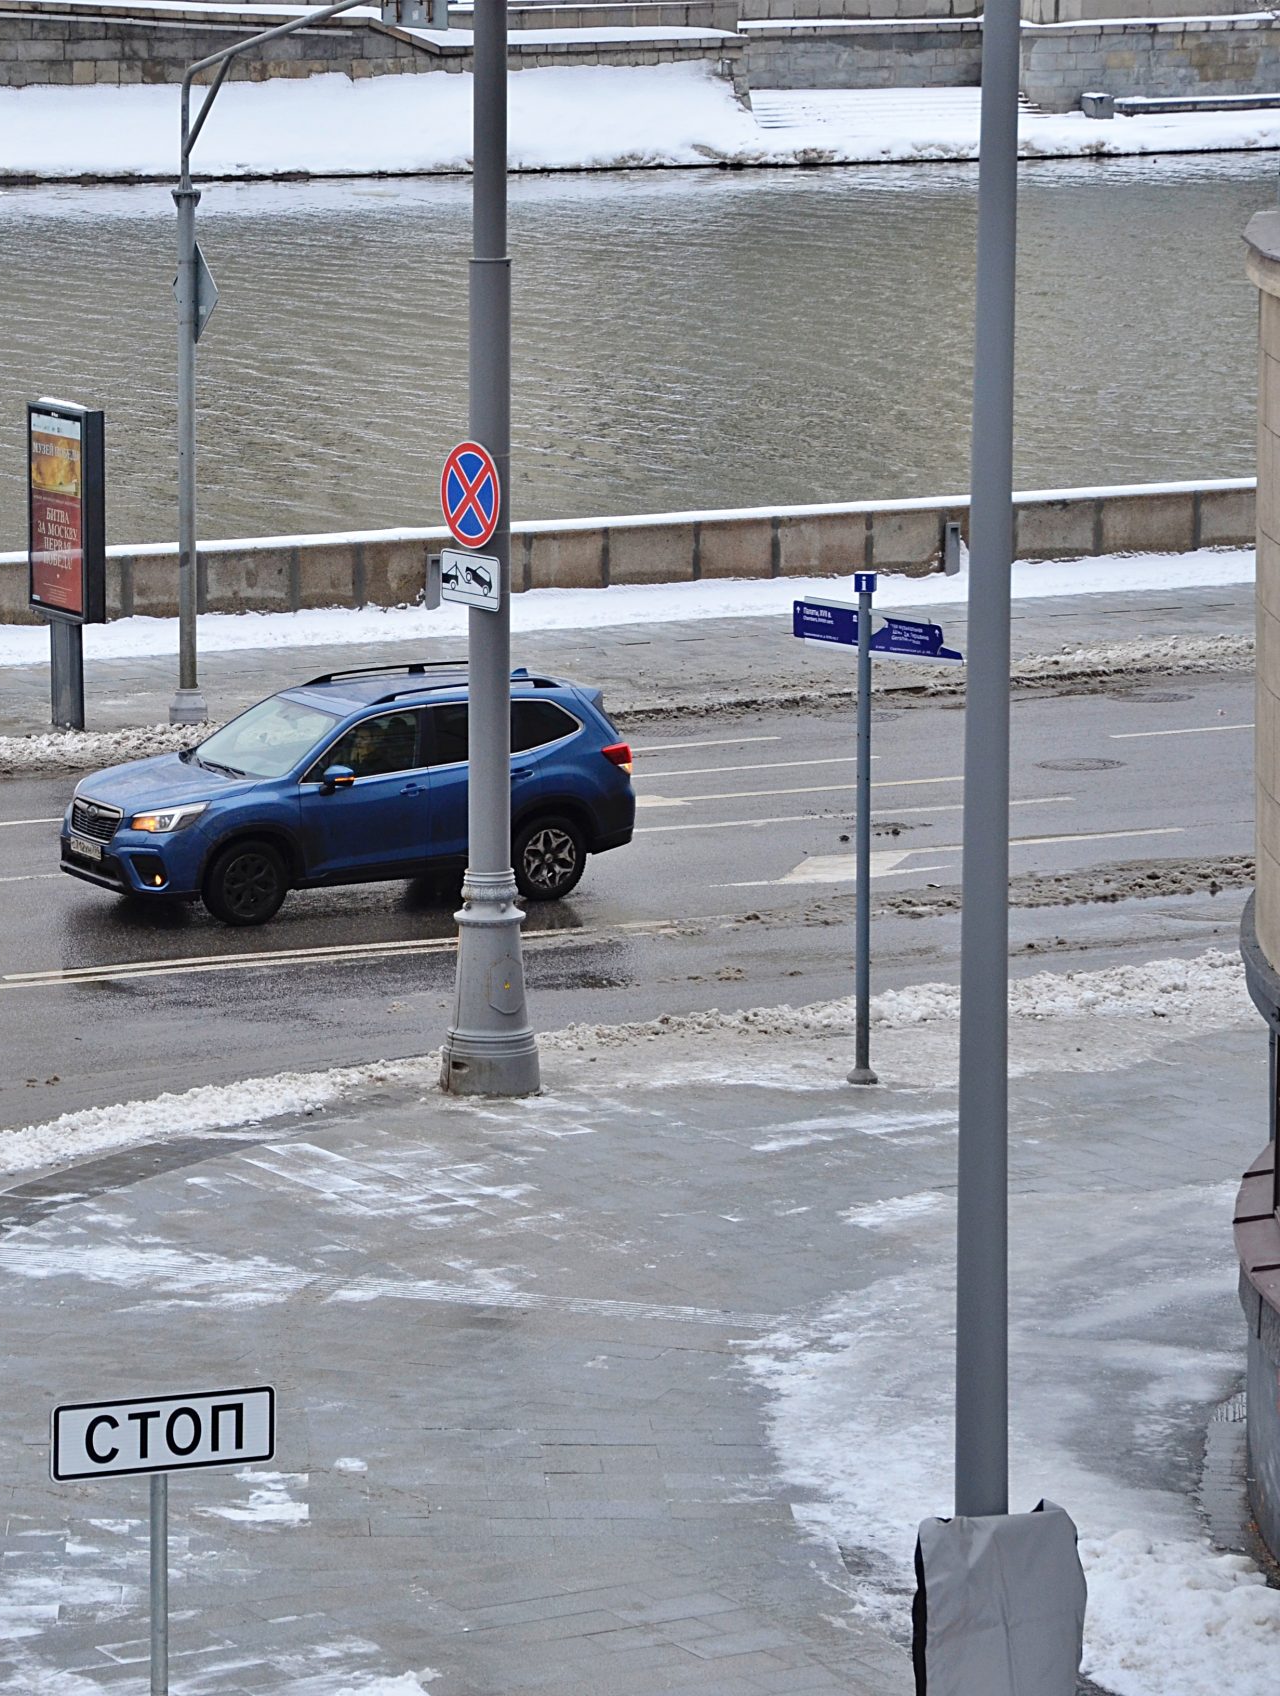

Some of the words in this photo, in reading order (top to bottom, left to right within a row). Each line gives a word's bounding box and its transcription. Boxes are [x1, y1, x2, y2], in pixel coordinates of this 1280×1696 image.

[32, 441, 54, 457] МУЗЕЙ
[46, 507, 70, 525] БИТВА
[37, 520, 46, 534] ЗА
[44, 536, 72, 554] ПЕРВАЯ
[85, 1403, 244, 1464] СТОП
